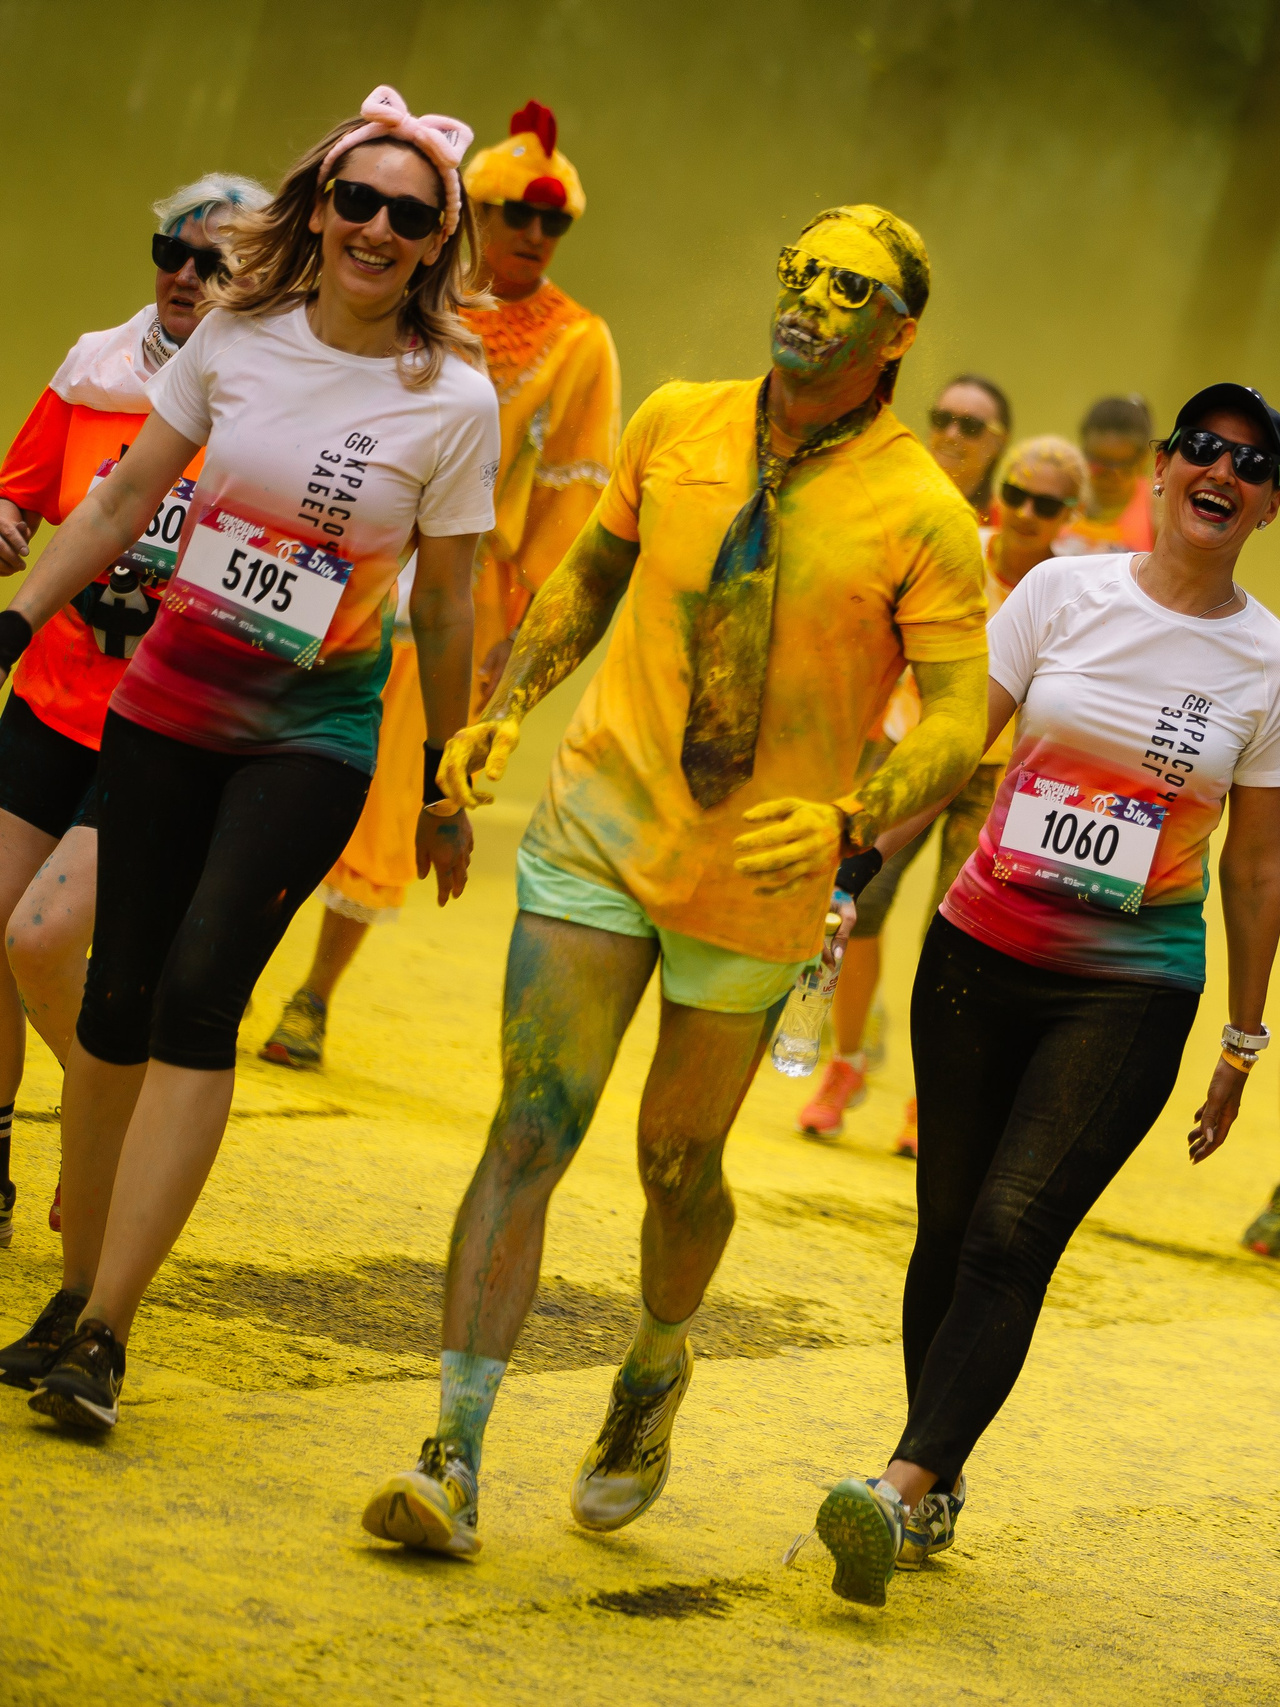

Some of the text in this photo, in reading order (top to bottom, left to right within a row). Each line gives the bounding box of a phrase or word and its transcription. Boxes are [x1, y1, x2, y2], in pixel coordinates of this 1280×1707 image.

[297, 450, 342, 527] ЗАБЕГ
[222, 549, 298, 612] 5195
[1142, 706, 1183, 777] ЗАБЕГ
[1041, 809, 1120, 866] 1060
